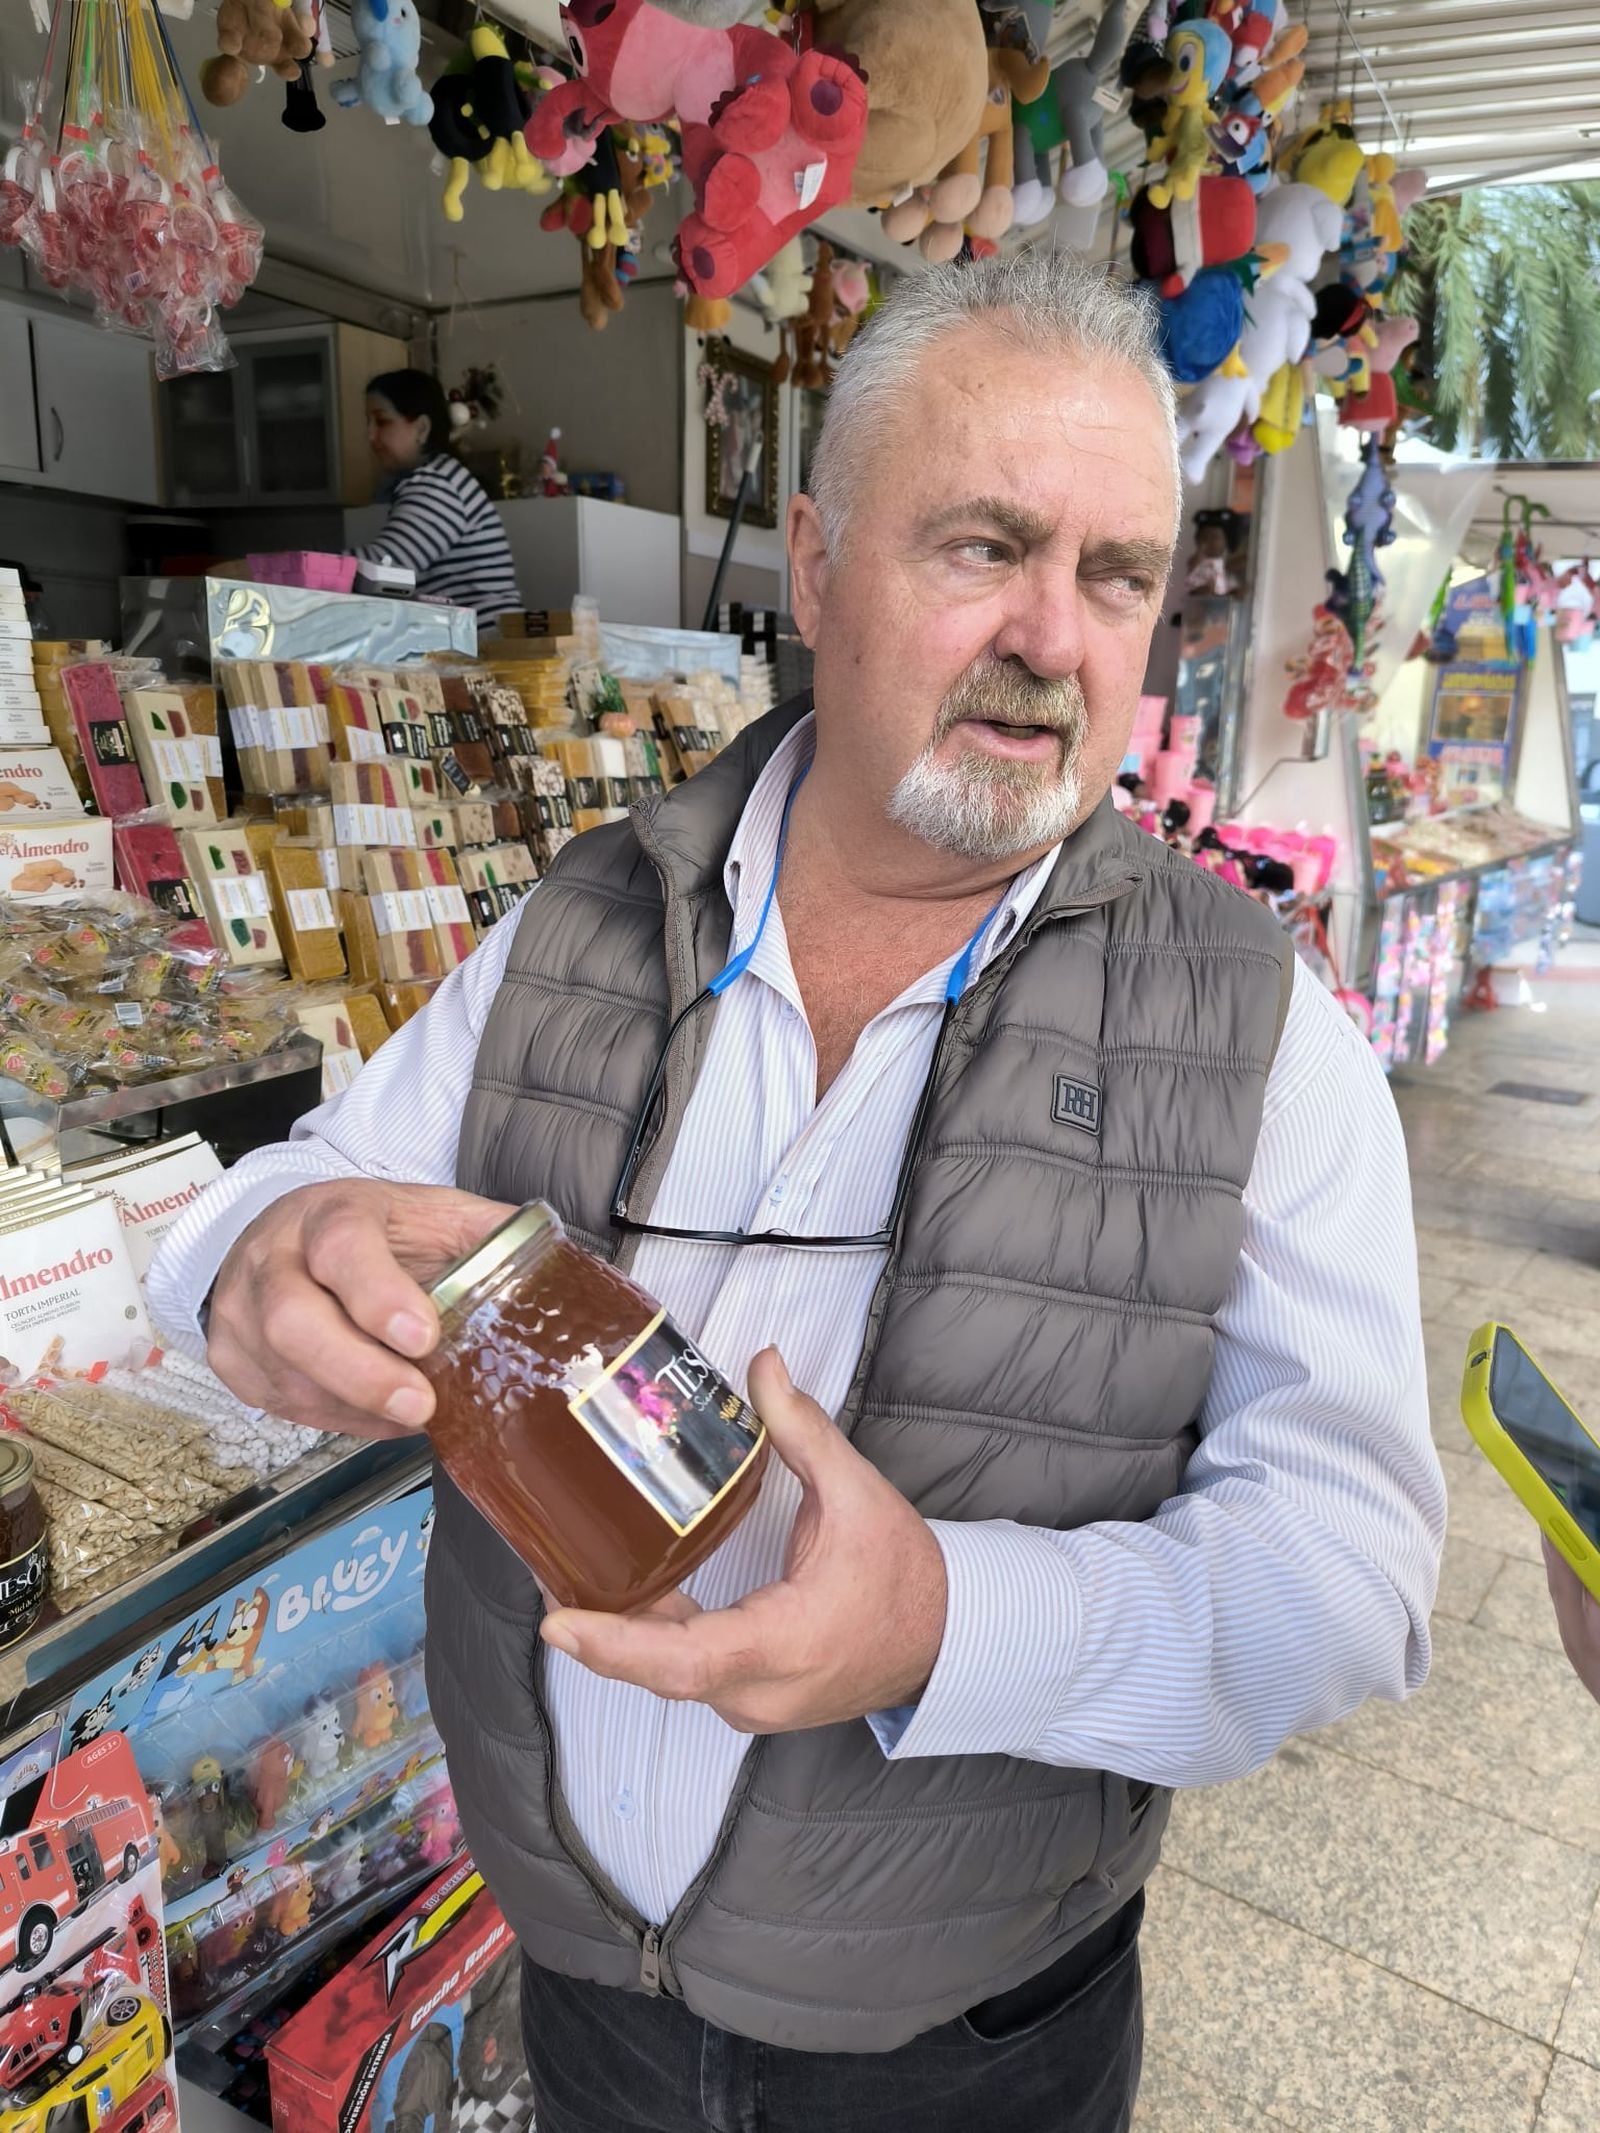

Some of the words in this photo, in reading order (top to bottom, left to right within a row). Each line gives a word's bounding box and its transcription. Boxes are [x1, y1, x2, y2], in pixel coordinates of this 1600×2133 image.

[10, 838, 89, 859] Almendro
[0, 1248, 113, 1301] lmendro
[4, 1303, 37, 1322] TORTA
[38, 1288, 81, 1310] IMPERIAL
[276, 1530, 408, 1633] BLUEY
[8, 1604, 25, 1617] Miel
[86, 1746, 107, 1764] AGES
[107, 1740, 118, 1751] 3+
[421, 1894, 441, 1911] TOP
[410, 1970, 460, 2031] Coche
[463, 1921, 506, 1975] Radio
[368, 2033, 393, 2079] EXTREMA
